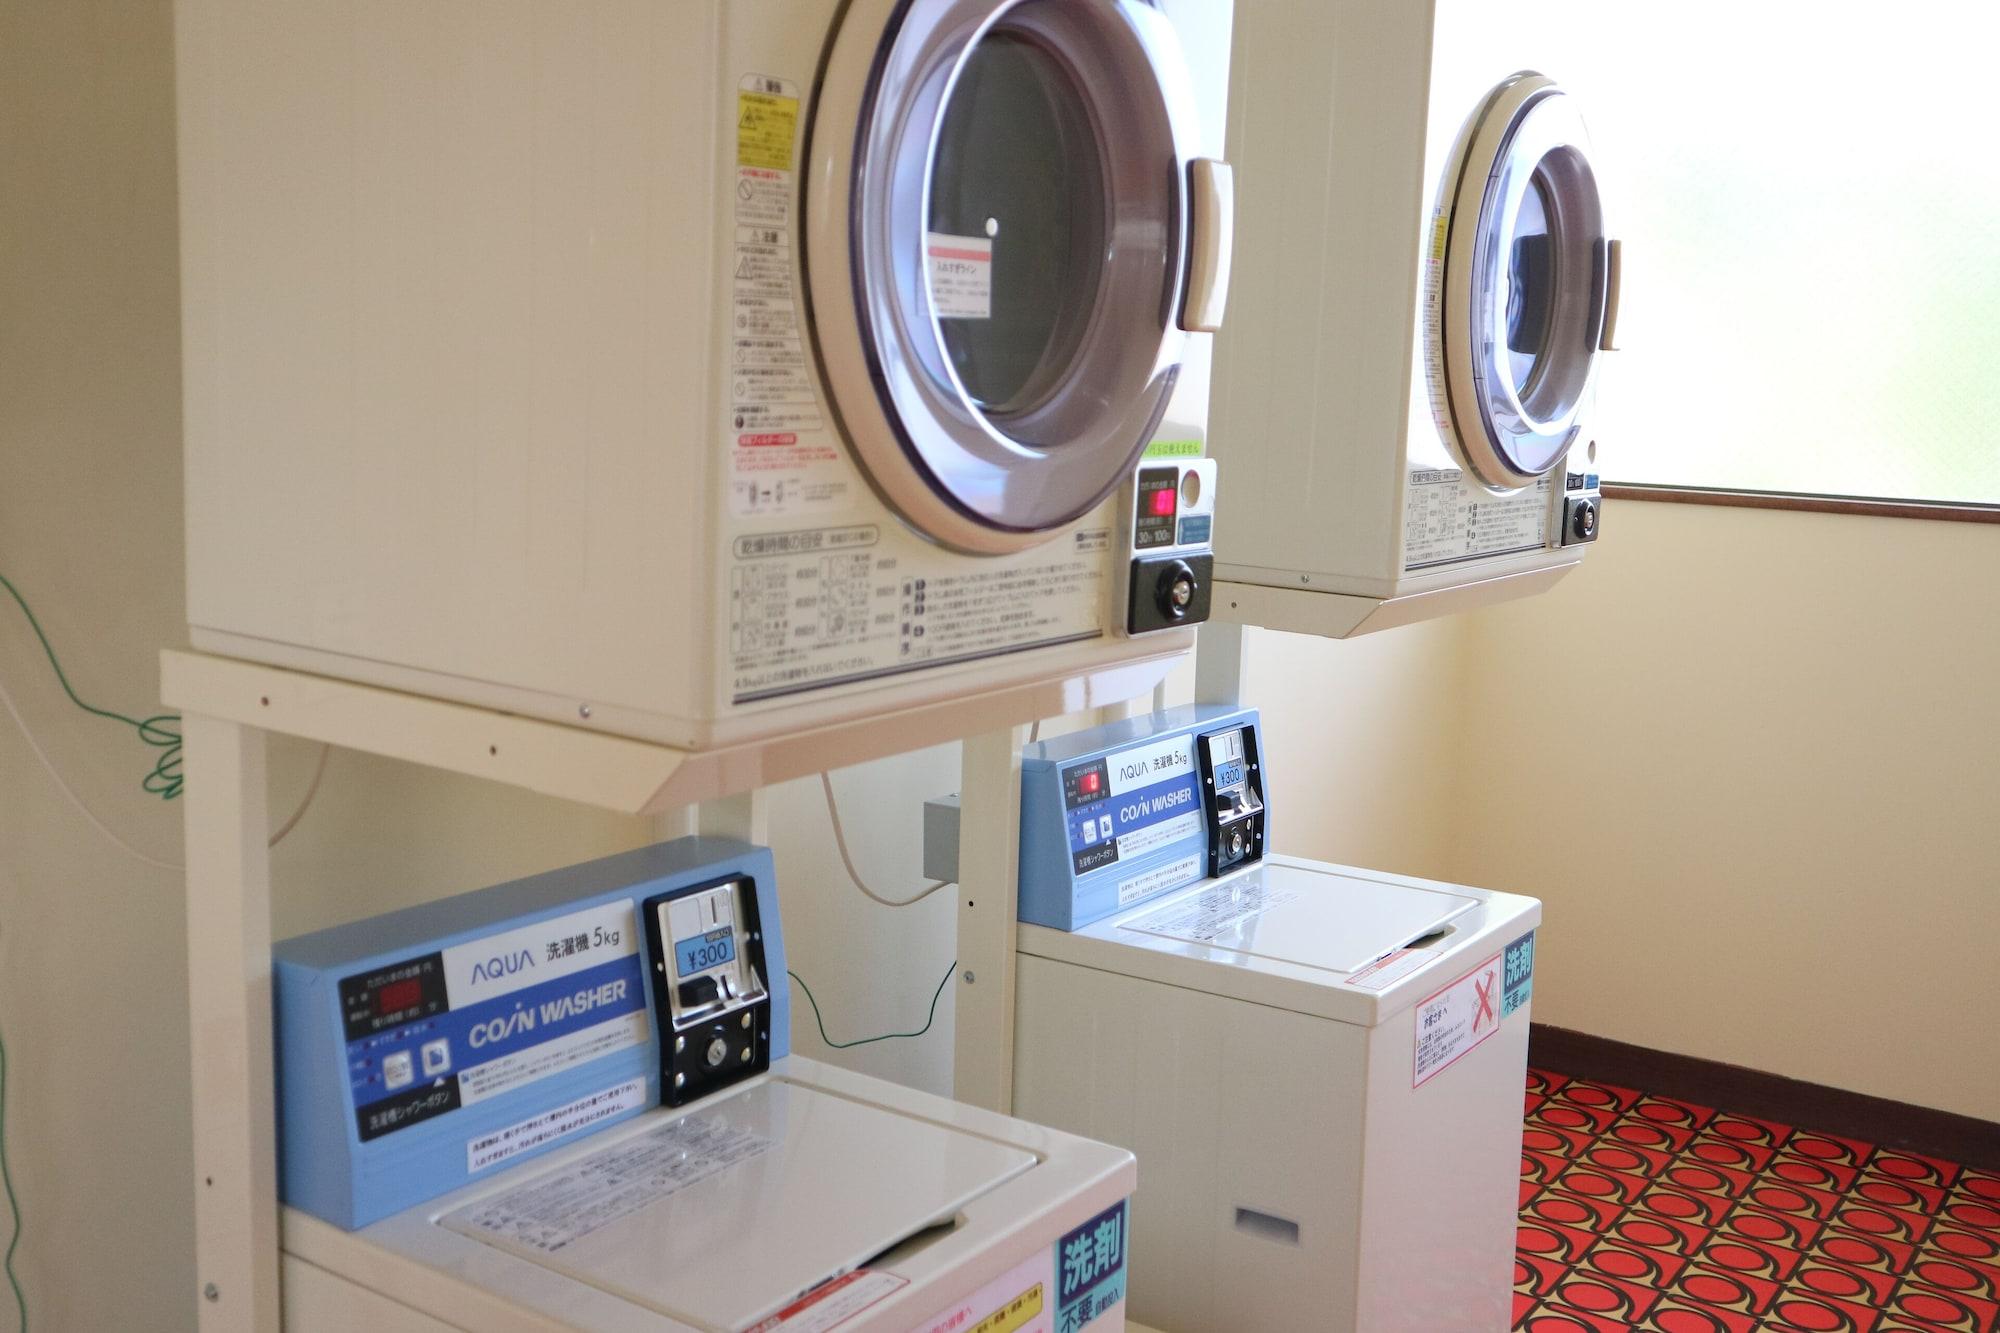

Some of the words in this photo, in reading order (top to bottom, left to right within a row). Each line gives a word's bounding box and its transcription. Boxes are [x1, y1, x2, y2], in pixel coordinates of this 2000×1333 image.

[1120, 764, 1149, 782] AQUA
[1153, 756, 1174, 770] 洗濯機
[1175, 751, 1188, 765] 5kg
[1221, 768, 1240, 785] ¥300
[1120, 796, 1149, 823] COIN
[1152, 787, 1192, 811] WASHER
[471, 950, 535, 985] AQUA
[546, 935, 590, 961] 洗濯機
[593, 927, 620, 947] 5kg
[688, 942, 727, 970] ¥300
[1506, 937, 1532, 987] 洗剤
[469, 1003, 535, 1049] COIN
[541, 978, 627, 1024] WASHER
[1504, 989, 1519, 1014] 不要
[1064, 1211, 1120, 1296] 洗剤
[1061, 1294, 1093, 1333] 不要
